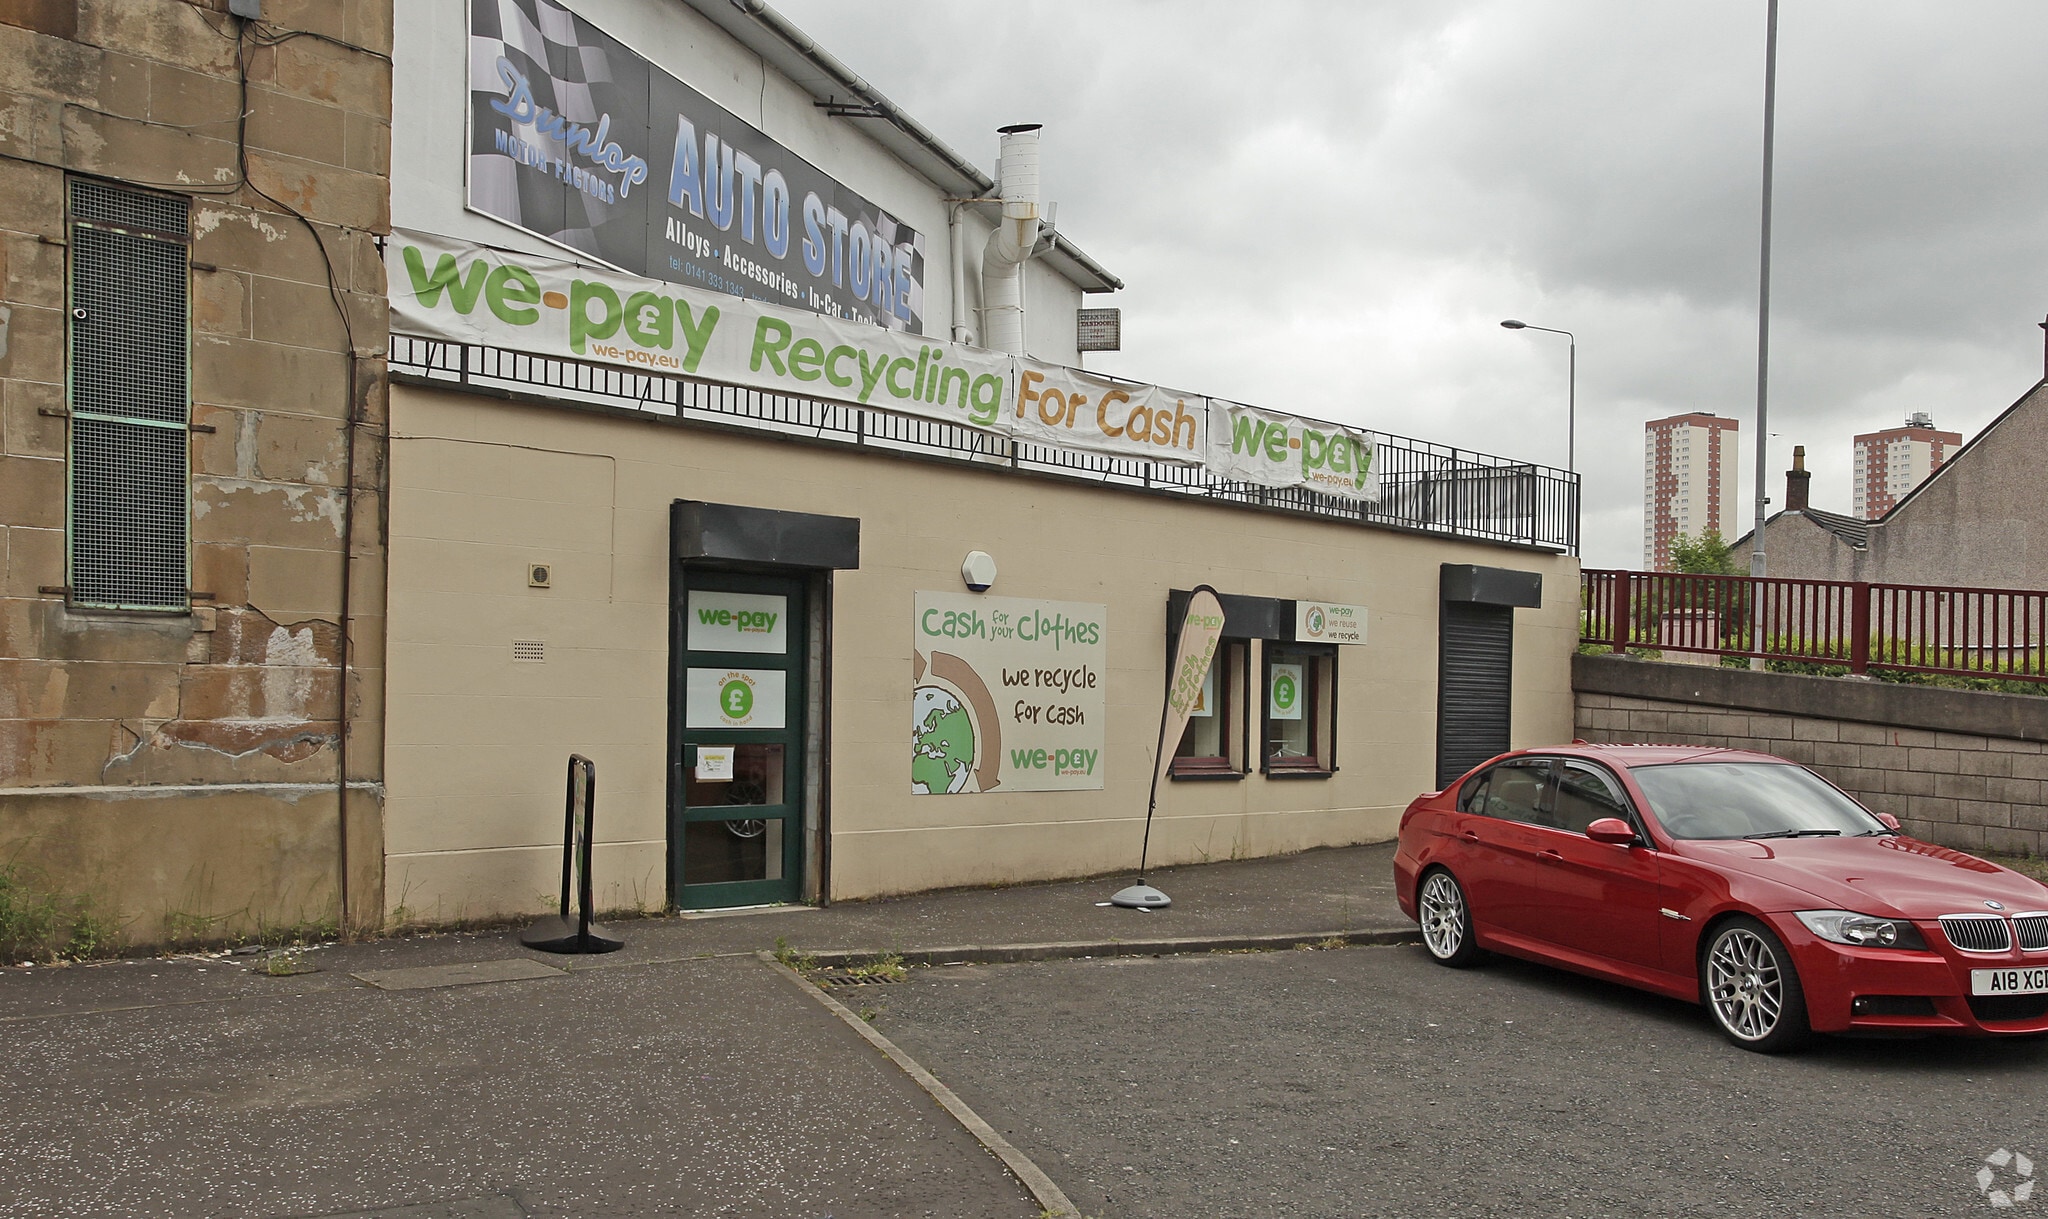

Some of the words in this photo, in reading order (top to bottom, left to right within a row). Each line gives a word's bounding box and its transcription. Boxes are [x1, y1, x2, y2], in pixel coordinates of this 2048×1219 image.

[489, 55, 648, 198] Dunlop
[495, 128, 548, 174] MOTOR
[555, 158, 615, 205] FACTORS
[668, 113, 790, 260] AUTO
[802, 191, 913, 325] STORE
[665, 216, 710, 258] Alloys
[723, 244, 799, 299] Accessories
[808, 285, 842, 319] In-Car
[669, 255, 683, 271] tel:
[685, 262, 707, 282] 0141
[708, 272, 723, 290] 333
[726, 281, 744, 298] 1343
[402, 245, 721, 374] we-pay
[750, 314, 1004, 428] Recycling
[591, 342, 680, 371] we-pay.eu
[1015, 369, 1087, 429] For
[1096, 389, 1197, 451] Cash
[1230, 413, 1373, 491] we-pay
[1312, 471, 1354, 487] we-pay.eu
[698, 608, 777, 633] we-pay
[921, 608, 986, 639] Cash
[992, 609, 1010, 624] for
[1328, 619, 1338, 627] we
[1340, 621, 1357, 629] reuse
[1329, 606, 1354, 617] we-pay
[990, 625, 1014, 642] your
[1016, 609, 1100, 651] Clothes
[1328, 631, 1337, 639] we
[1338, 632, 1360, 641] recycle
[727, 671, 739, 679] the
[741, 673, 756, 686] spot
[1002, 667, 1029, 687] we
[1034, 664, 1097, 694] recycle
[1014, 699, 1041, 724] for
[1010, 748, 1098, 776] we-pay
[1991, 971, 2018, 991] A18
